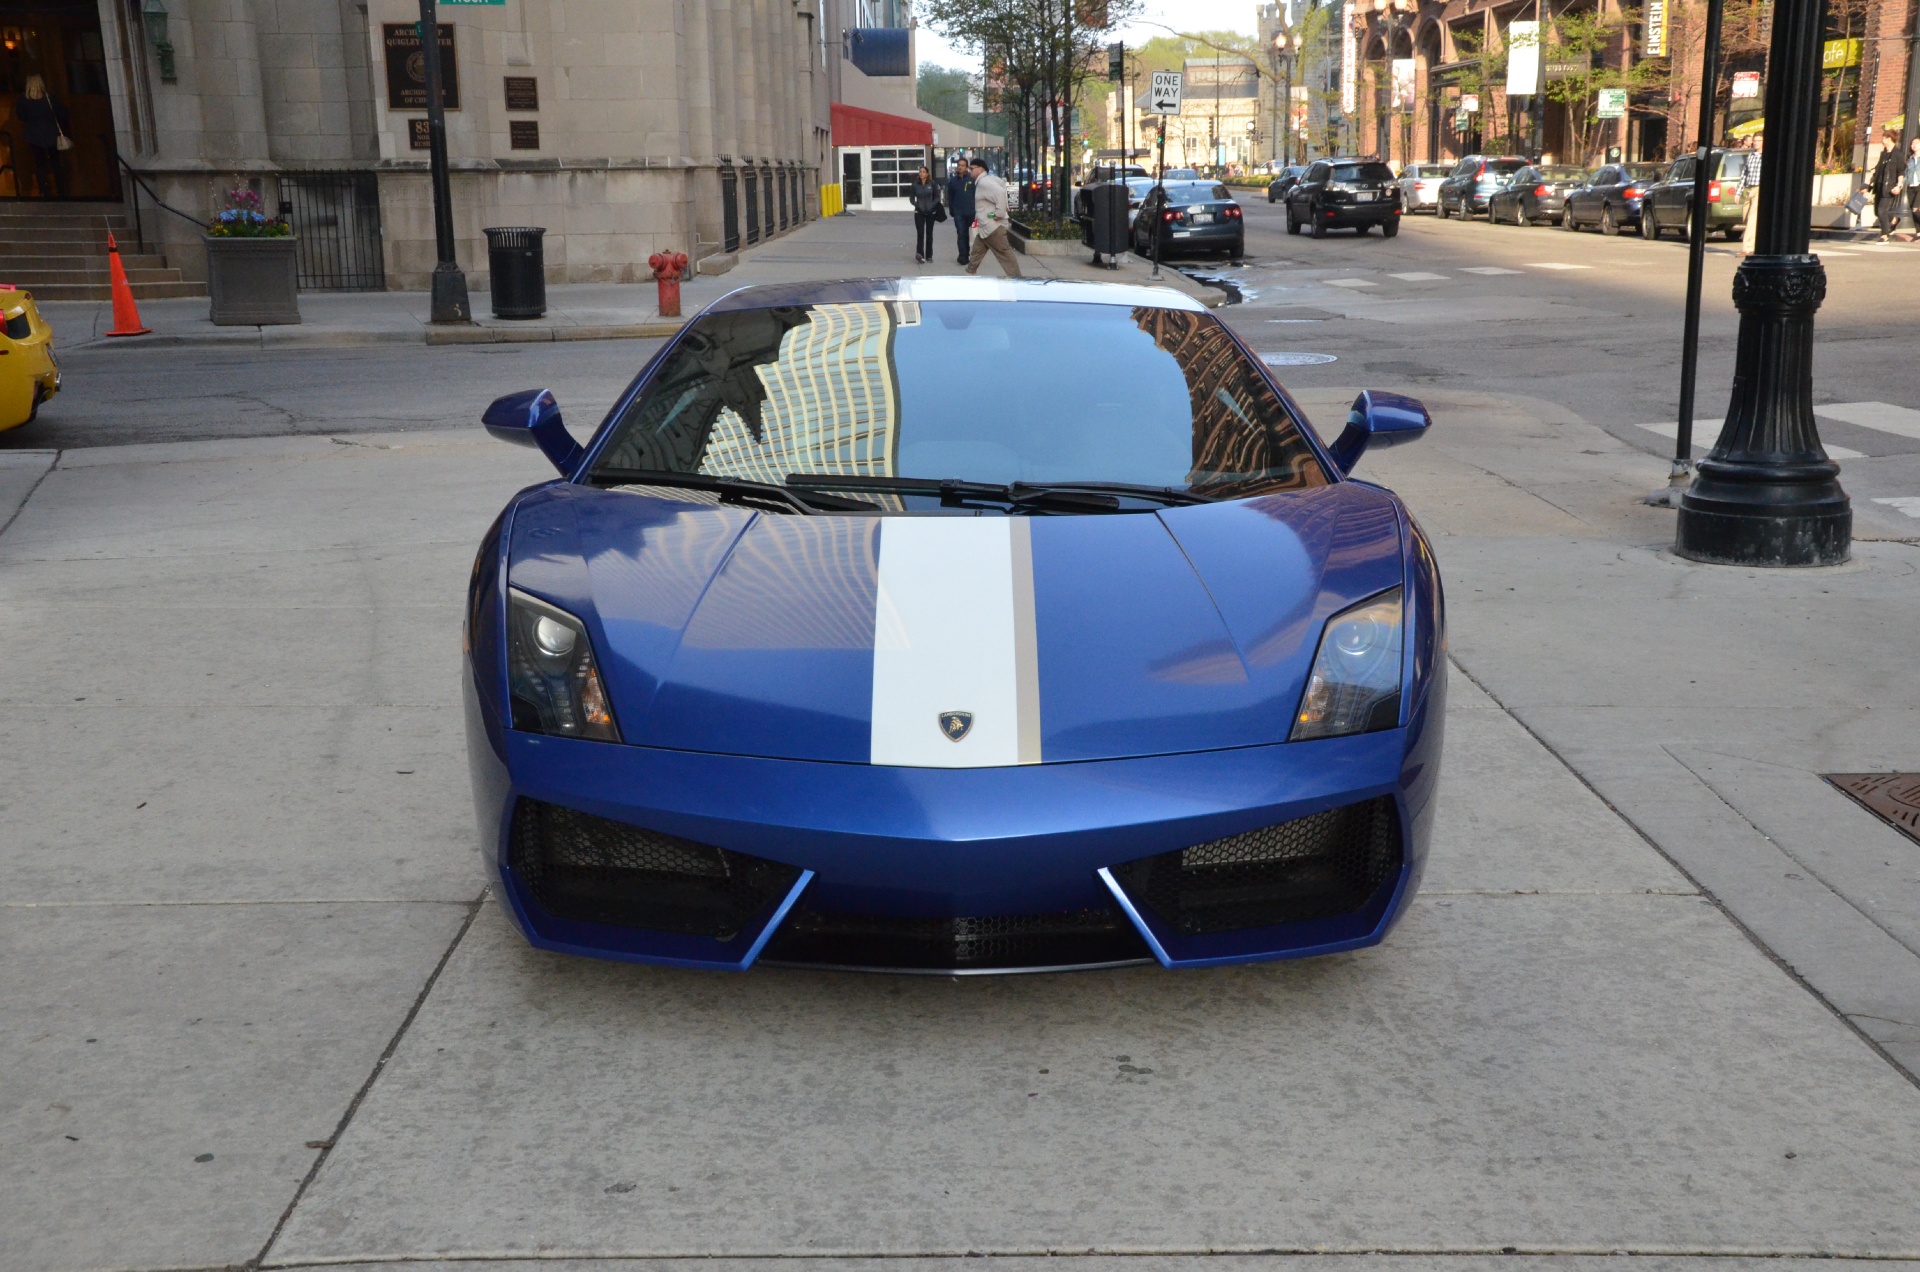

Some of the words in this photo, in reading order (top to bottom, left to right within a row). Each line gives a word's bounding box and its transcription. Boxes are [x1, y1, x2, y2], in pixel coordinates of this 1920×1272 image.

[1647, 2, 1662, 55] EINSTEIN
[386, 38, 420, 47] QUIGLEY
[1823, 42, 1844, 62] afé
[1155, 75, 1179, 86] ONE
[1154, 87, 1179, 98] WAY
[415, 121, 430, 134] 83
